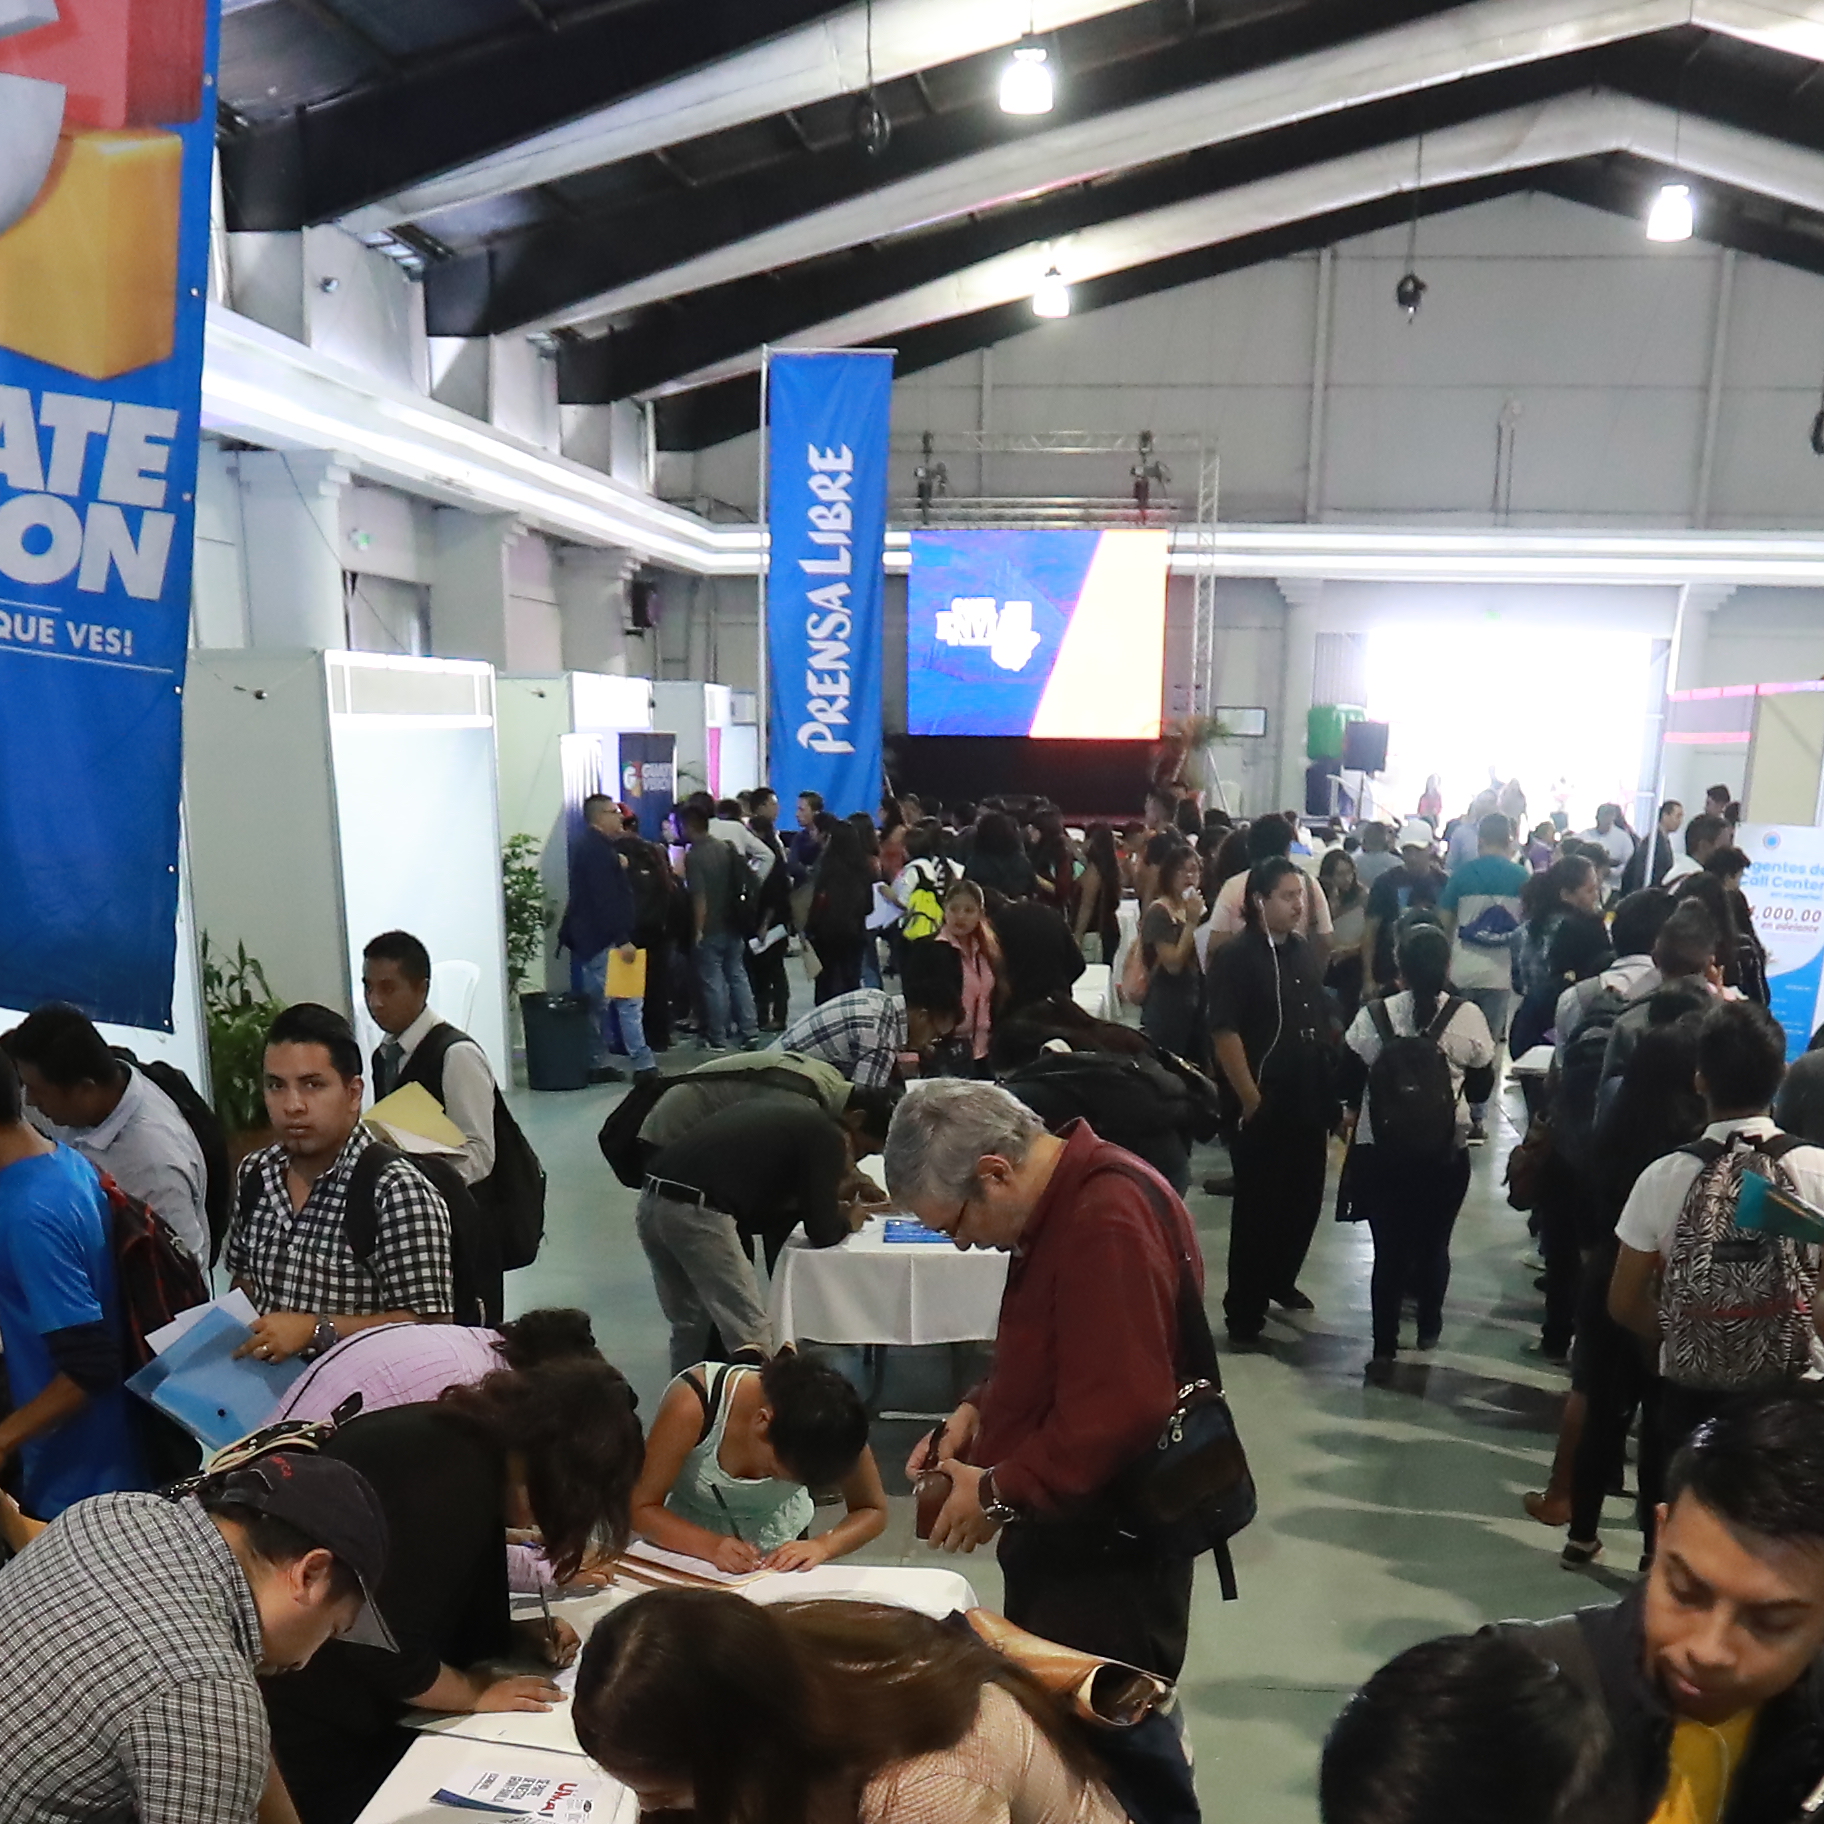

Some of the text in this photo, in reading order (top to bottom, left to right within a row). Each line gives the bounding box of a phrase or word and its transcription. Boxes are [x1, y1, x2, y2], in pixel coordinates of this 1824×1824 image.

[66, 622, 134, 657] VES!
[797, 442, 856, 755] PRENSA LIBRE
